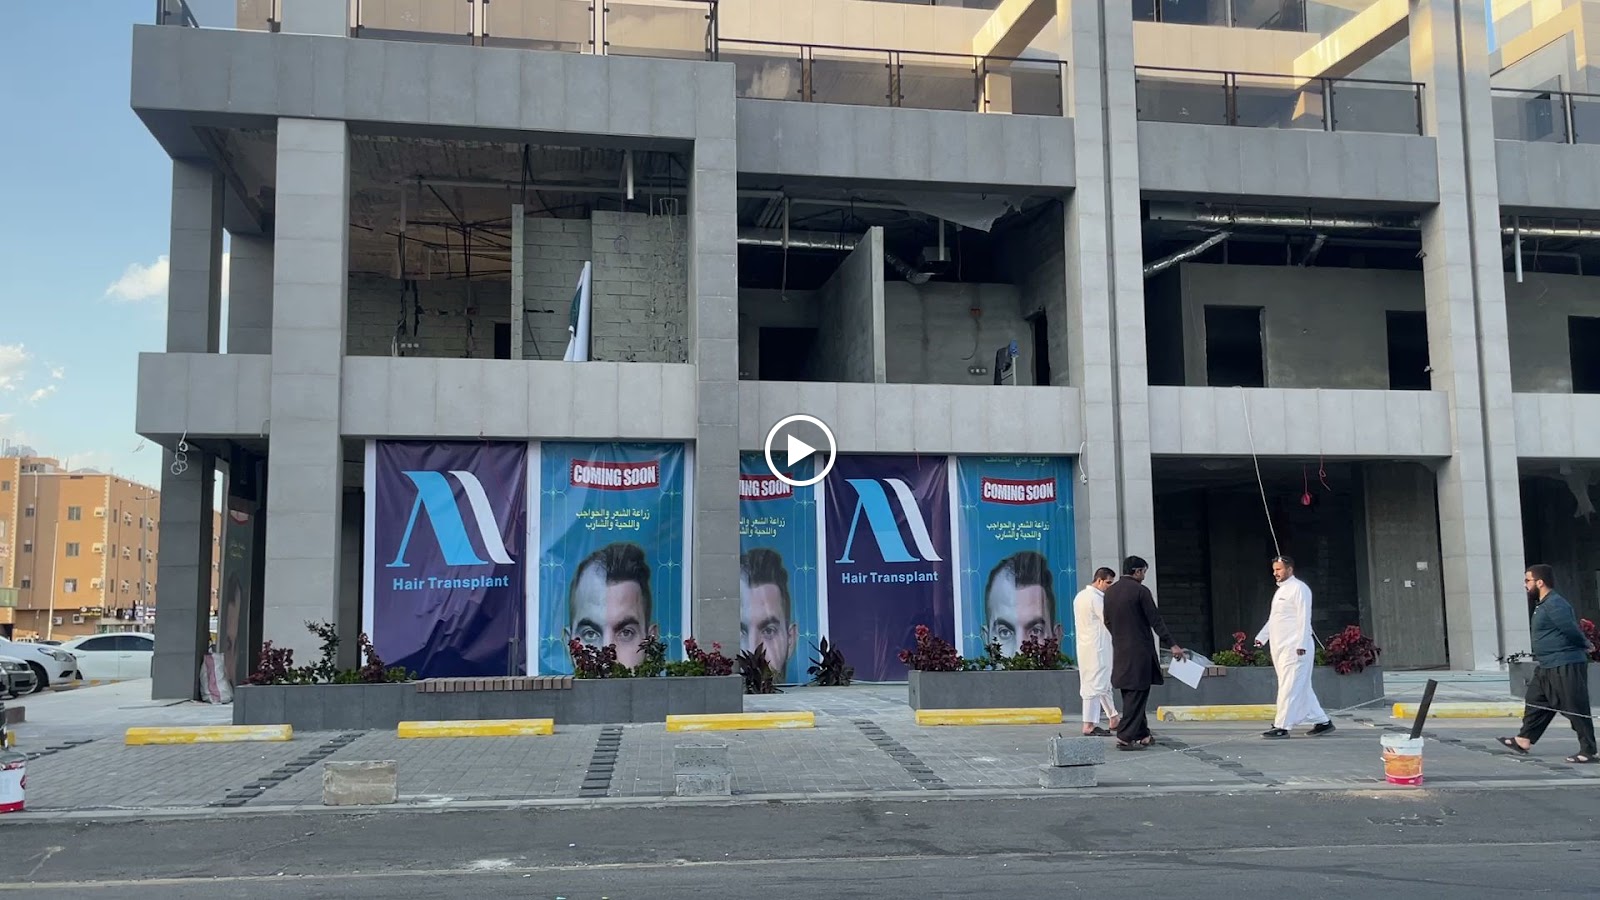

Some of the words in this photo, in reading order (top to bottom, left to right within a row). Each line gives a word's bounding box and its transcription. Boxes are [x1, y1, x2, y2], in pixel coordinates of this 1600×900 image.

[573, 464, 622, 487] COMING
[623, 465, 656, 486] SOON
[739, 480, 760, 497] ING
[761, 479, 790, 496] SOON
[983, 481, 1025, 501] COMING
[1026, 482, 1054, 501] SOON
[575, 508, 610, 520] والحواجب
[611, 508, 631, 520] الشعر
[632, 508, 650, 520] زراعة
[585, 519, 614, 530] والشارب
[615, 519, 640, 530] واللحية
[392, 578, 425, 591] Hair
[427, 575, 510, 591] Transplant
[841, 573, 868, 584] Hair
[870, 571, 939, 584] Transplant
